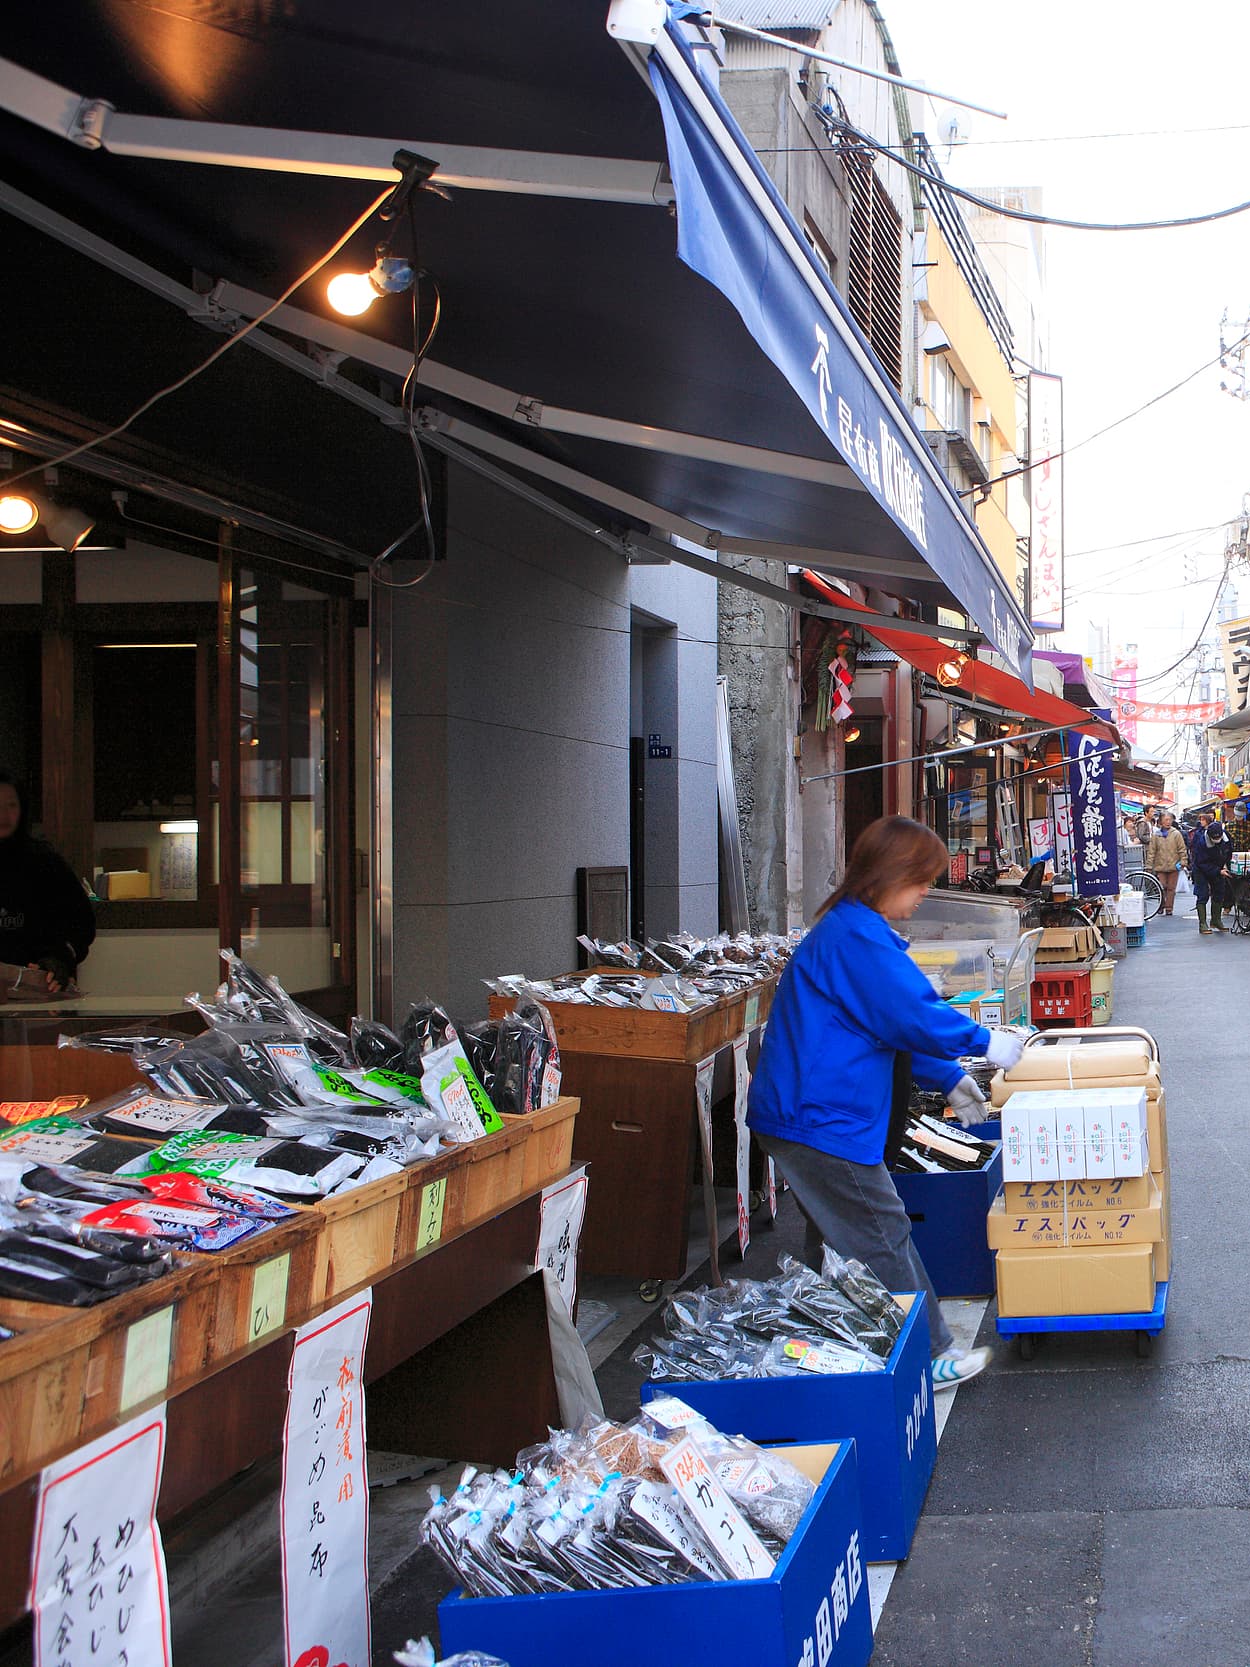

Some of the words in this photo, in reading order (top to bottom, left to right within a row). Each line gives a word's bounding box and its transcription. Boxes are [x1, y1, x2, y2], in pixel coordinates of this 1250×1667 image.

[1013, 1214, 1136, 1232] エス・バッグ
[308, 1385, 330, 1578] がごめ昆布
